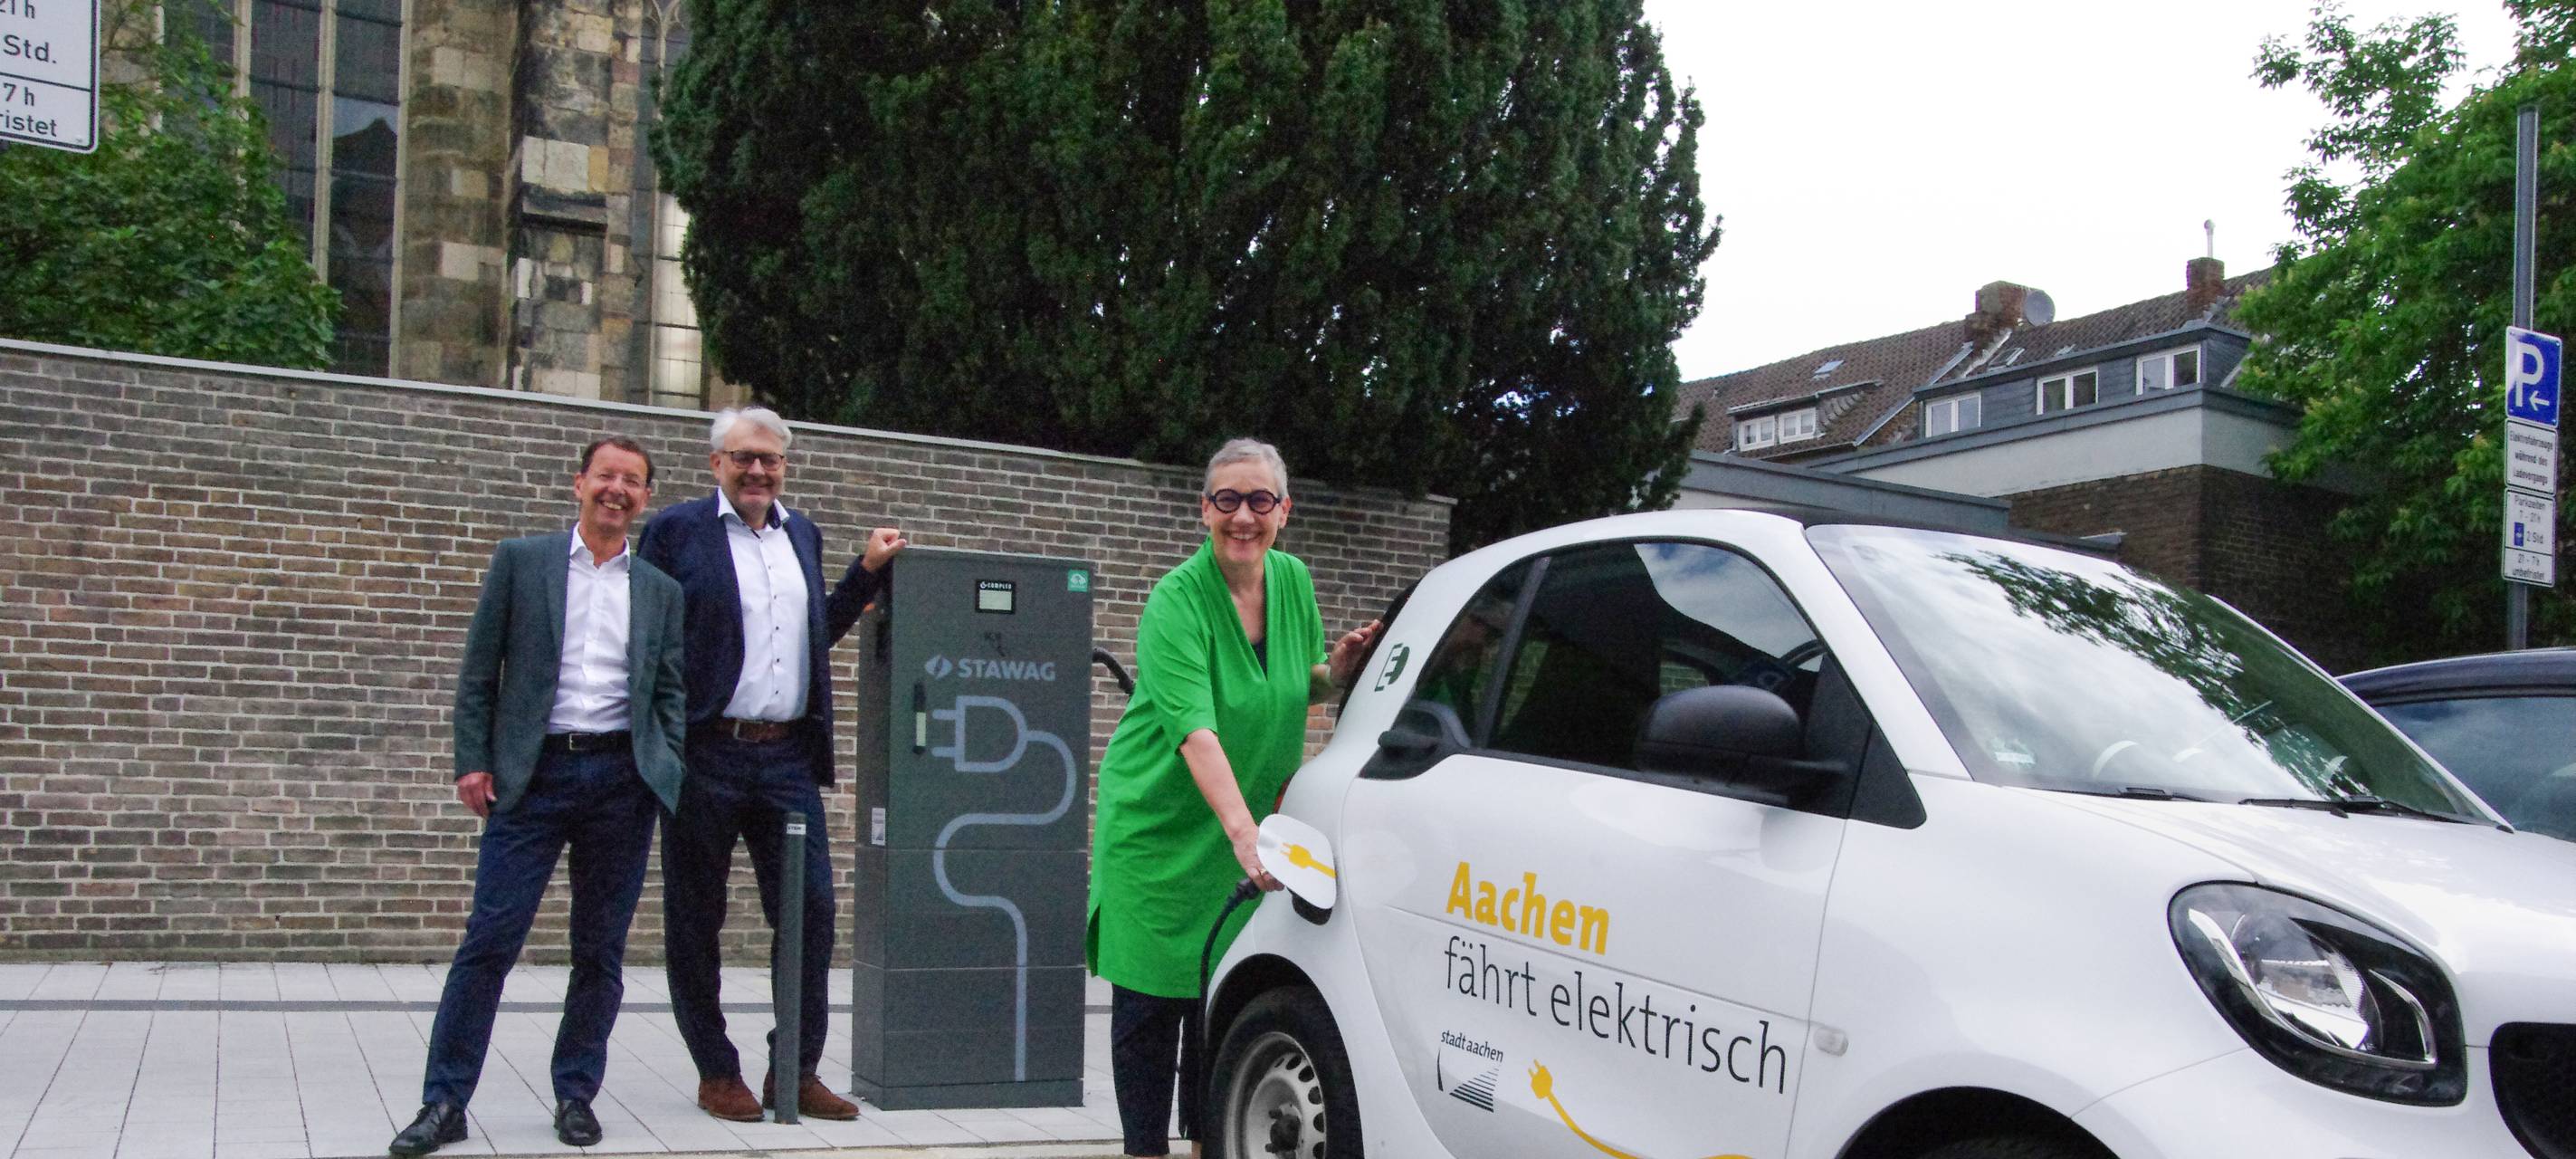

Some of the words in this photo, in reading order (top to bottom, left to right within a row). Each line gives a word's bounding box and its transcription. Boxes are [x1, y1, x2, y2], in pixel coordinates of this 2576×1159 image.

[24, 0, 35, 19] h
[3, 34, 57, 64] Std.
[4, 82, 16, 102] 7
[24, 87, 35, 107] h
[2514, 340, 2544, 407] P
[958, 658, 1055, 681] STAWAG
[1445, 861, 1609, 956] Aachen
[1445, 935, 1537, 1017] fährt
[1550, 971, 1786, 1095] elektrisch
[1441, 1030, 1466, 1050] stadt
[1466, 1041, 1503, 1063] aachen
